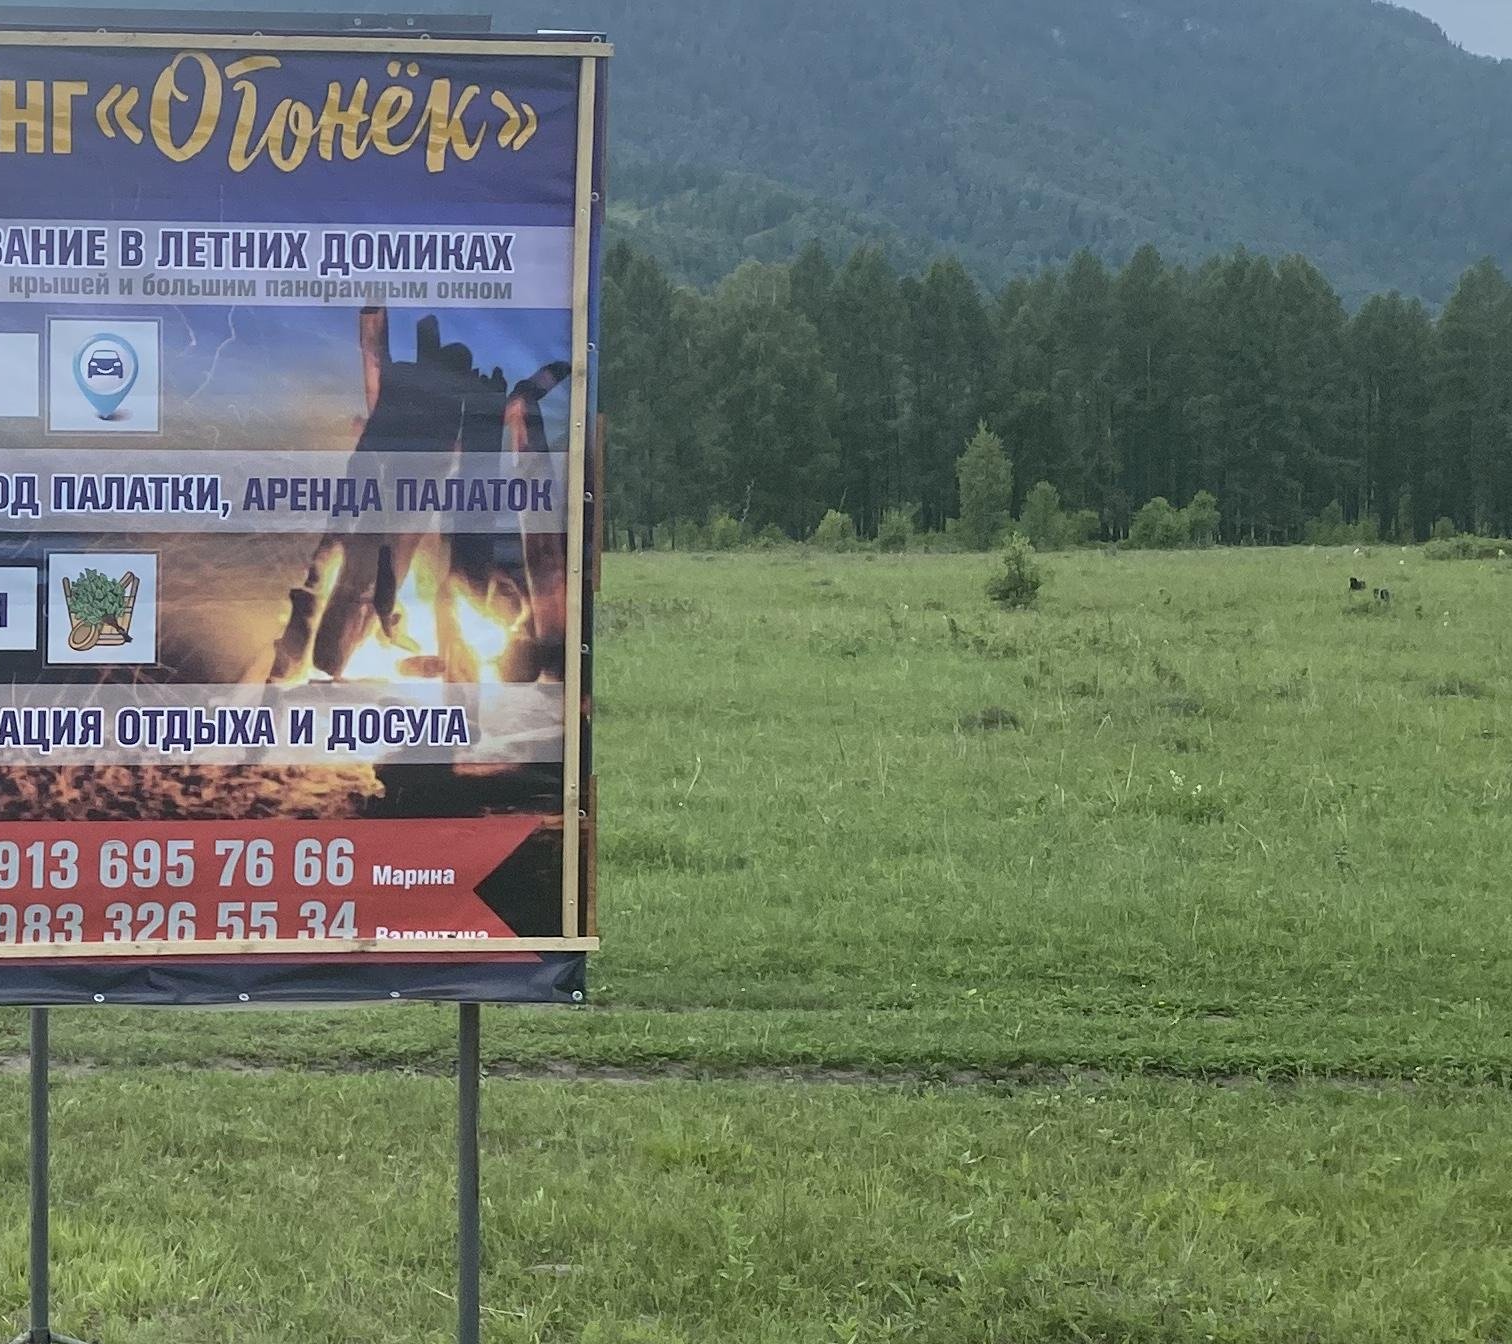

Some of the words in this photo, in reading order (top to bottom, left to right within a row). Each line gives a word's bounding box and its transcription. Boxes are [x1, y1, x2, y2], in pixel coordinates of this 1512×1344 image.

[118, 229, 146, 268] В
[157, 229, 307, 270] ЛЕТНИХ
[319, 231, 516, 277] ДОМИКАХ
[9, 273, 109, 296] крышей
[119, 278, 133, 296] и
[142, 273, 256, 297] большим
[265, 279, 428, 303] панорамным
[437, 281, 513, 299] окном
[51, 474, 231, 518] ПАЛАТКИ,
[242, 477, 382, 517] АРЕНДА
[396, 478, 553, 512] ПАЛАТОК
[115, 706, 276, 752] ОТДЫХА
[289, 707, 315, 747] И
[326, 706, 470, 751] ДОСУГА
[99, 839, 195, 888] 695
[215, 838, 274, 887] 76
[294, 838, 355, 886] 66
[372, 865, 455, 890] Марина
[103, 901, 196, 942] 326
[216, 901, 278, 940] 55
[297, 901, 358, 939] 34
